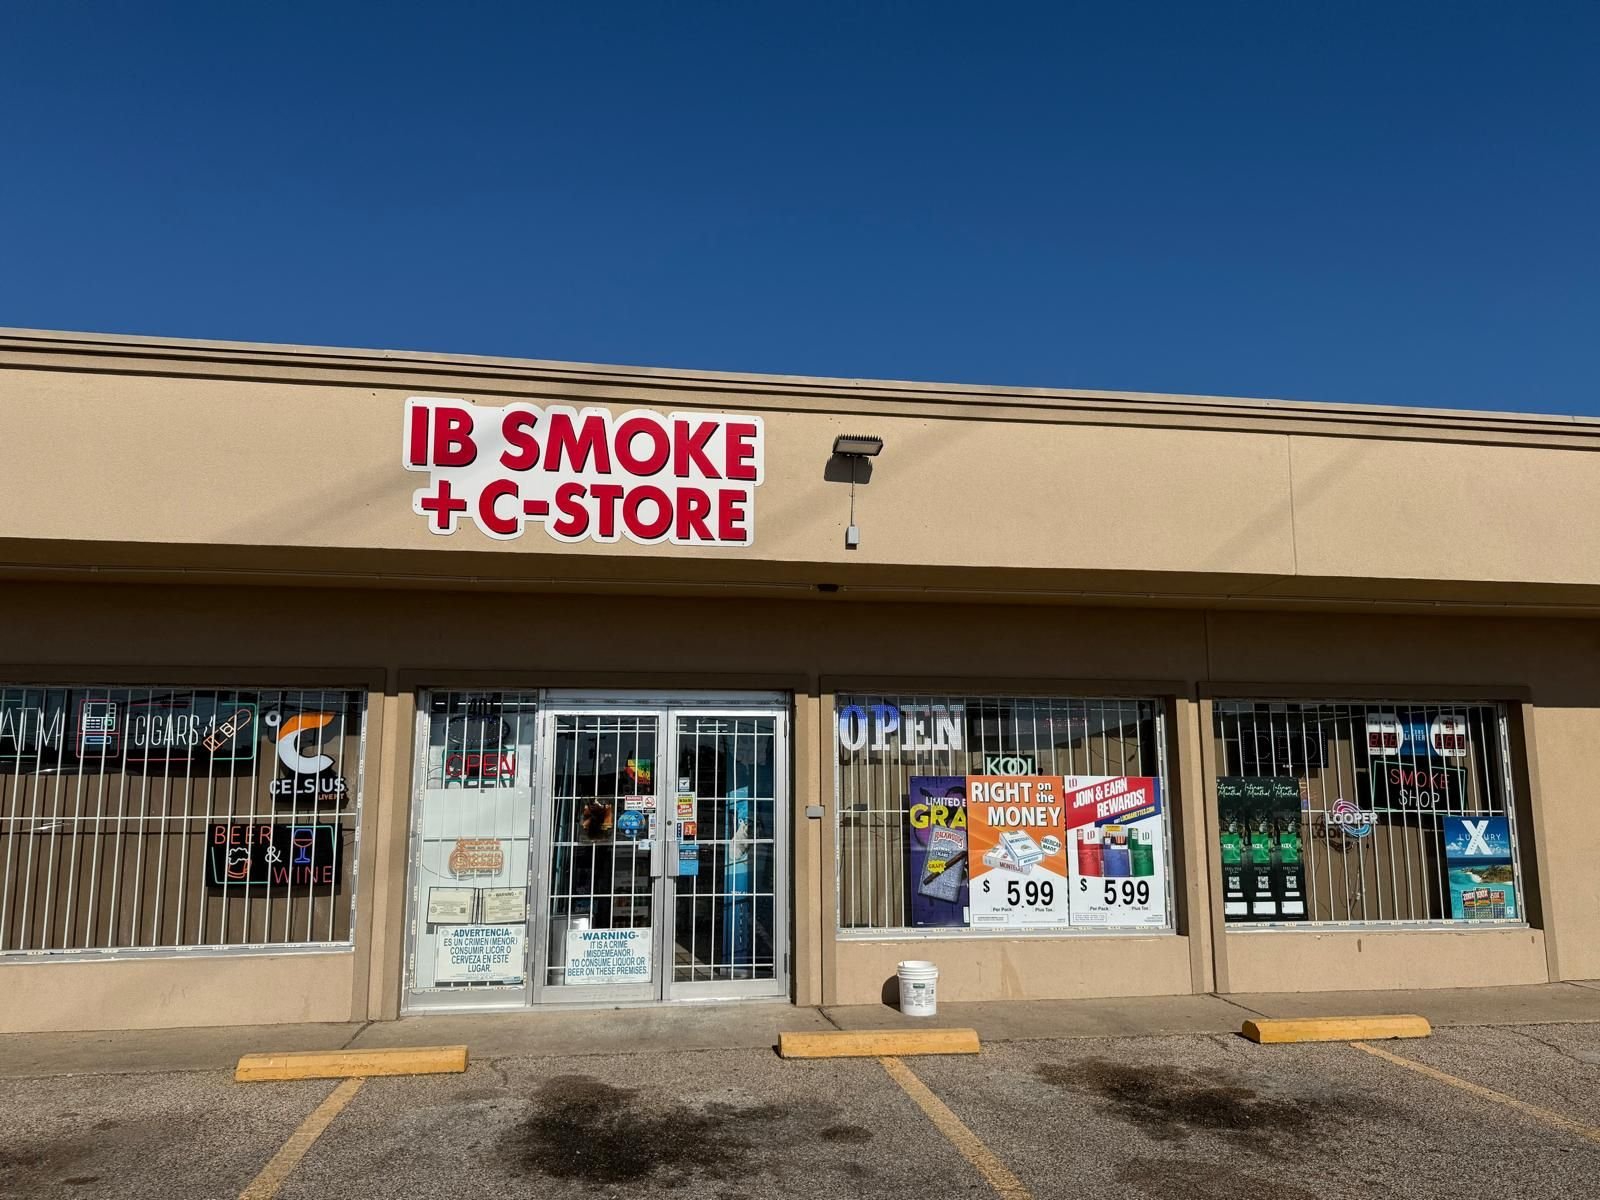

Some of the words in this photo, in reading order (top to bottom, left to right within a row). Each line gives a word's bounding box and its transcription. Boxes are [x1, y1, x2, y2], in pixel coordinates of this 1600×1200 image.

[410, 406, 478, 467] IB
[499, 410, 758, 481] SMOKE
[478, 478, 748, 541] C-STORE
[0, 706, 62, 751] ATM
[135, 714, 200, 746] CIGARS
[839, 704, 964, 751] OPEN
[446, 754, 516, 777] OPEN
[987, 755, 1037, 776] KOOL
[270, 777, 345, 794] CELSIUS
[1390, 769, 1450, 790] SMOKE
[925, 796, 960, 807] LIMITED
[971, 782, 1033, 803] RIGHT
[1037, 783, 1052, 791] on
[1035, 792, 1055, 803] the
[1073, 789, 1094, 808] JOIN
[1095, 786, 1104, 800] &
[1104, 777, 1128, 798] EARN
[1399, 789, 1440, 808] SHOP
[1097, 788, 1146, 818] REWARDS!
[988, 806, 1062, 827] MONEY
[1327, 812, 1378, 825] LOOPER
[214, 825, 273, 845] BEER
[933, 831, 964, 849] BACKWOODS
[264, 846, 282, 863] &
[272, 865, 334, 884] WINE
[983, 879, 990, 893] $
[1007, 880, 1054, 909] 5.99
[1080, 878, 1088, 892] $
[1104, 879, 1150, 908] 5.99
[451, 928, 512, 937] -ADVERTENCIA-
[454, 938, 462, 946] UN
[464, 937, 489, 946] CRIMEN
[490, 937, 518, 945] (MENOR)
[579, 931, 639, 940] -WARNING-
[450, 946, 484, 955] CONSUMIR
[485, 946, 505, 954] LICOR
[506, 946, 511, 954] O
[590, 941, 596, 949] IT
[596, 941, 603, 949] IS
[609, 940, 628, 948] CRIME
[451, 955, 480, 964] CERVEZA
[482, 955, 492, 963] EN
[492, 955, 509, 963] ESTE
[467, 964, 491, 972] LUGAR.
[571, 959, 580, 967] TO
[581, 958, 611, 967] CONSUME
[612, 957, 635, 966] LIQUOR
[636, 957, 645, 965] OR
[568, 968, 584, 976] BEER
[585, 967, 594, 976] ON
[596, 967, 615, 975] THESE
[616, 966, 648, 975] PREMISES.
